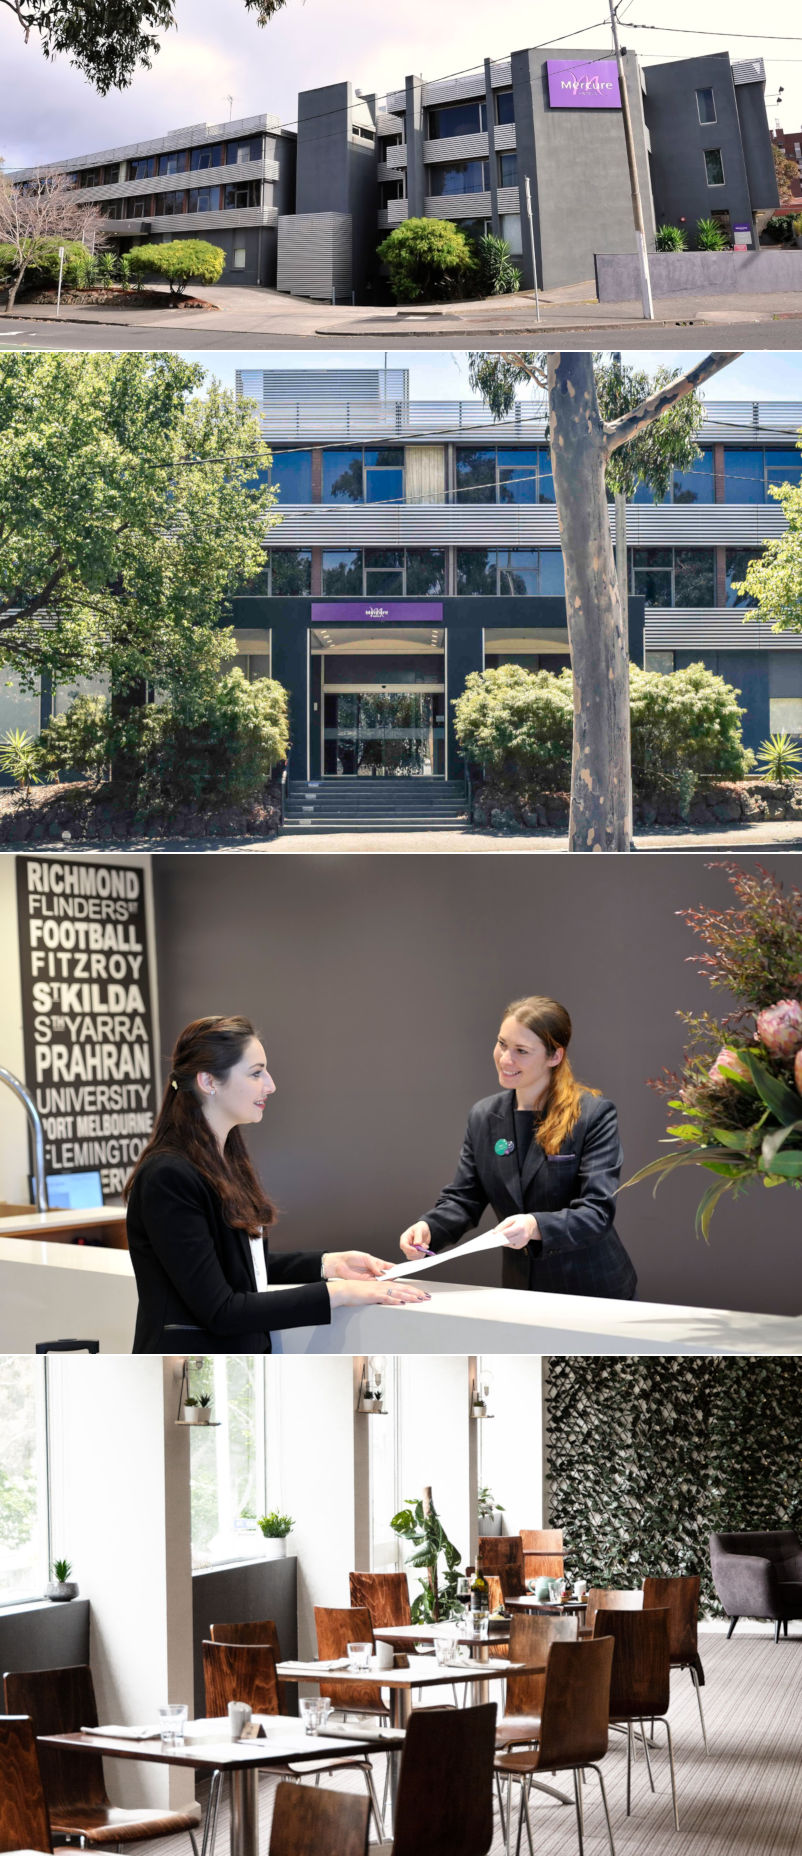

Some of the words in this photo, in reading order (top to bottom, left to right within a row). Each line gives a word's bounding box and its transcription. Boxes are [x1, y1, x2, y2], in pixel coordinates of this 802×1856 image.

[560, 80, 613, 90] Mercure
[26, 861, 140, 900] RICHMOND
[29, 918, 143, 952] FOOTBALL
[31, 951, 143, 979] FITZROY
[35, 1043, 151, 1082] PRAHRAN
[36, 1084, 152, 1114] UNIVERSITY
[76, 1112, 153, 1138] MELBOURNE
[101, 1166, 135, 1194] ERV
